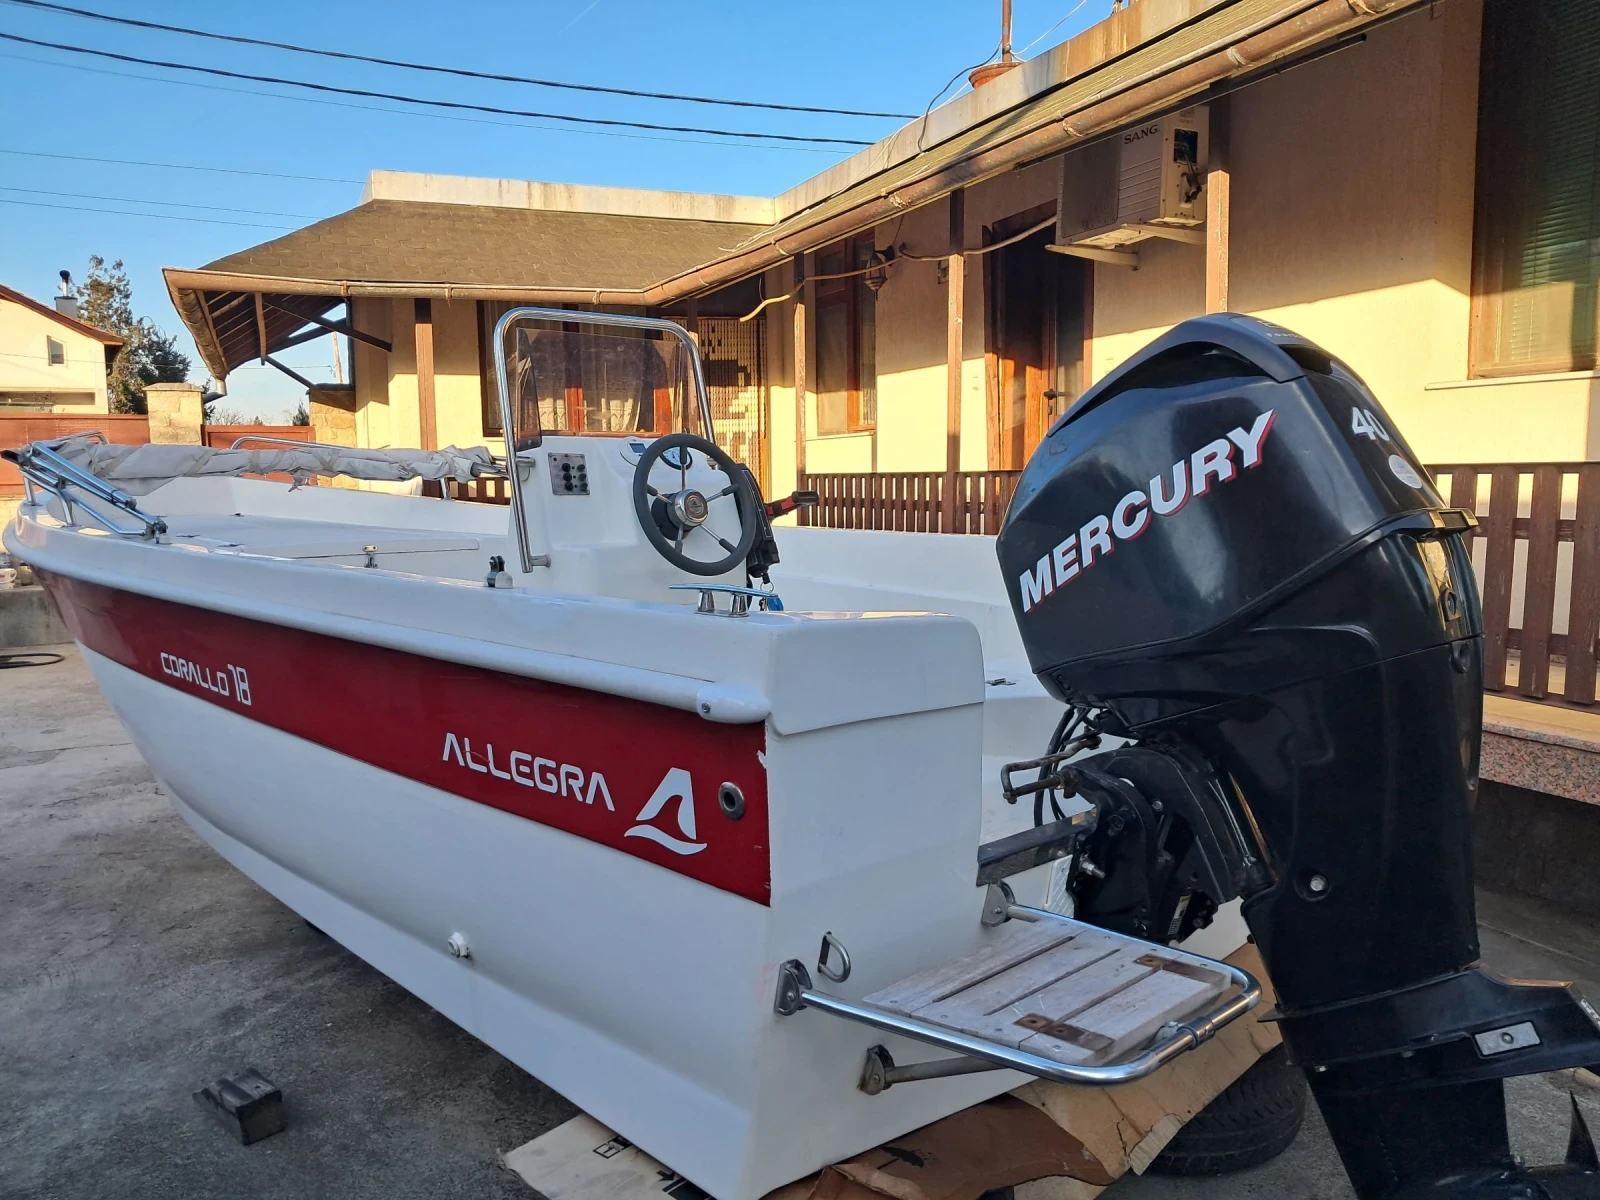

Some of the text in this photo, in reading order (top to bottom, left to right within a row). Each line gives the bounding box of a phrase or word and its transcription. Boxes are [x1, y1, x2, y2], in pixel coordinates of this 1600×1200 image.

[1123, 124, 1159, 145] SANG
[1351, 406, 1391, 442] 40
[1018, 407, 1278, 615] MERCURY
[160, 651, 252, 706] CORALLO 18
[442, 732, 616, 812] ALLEGRA
